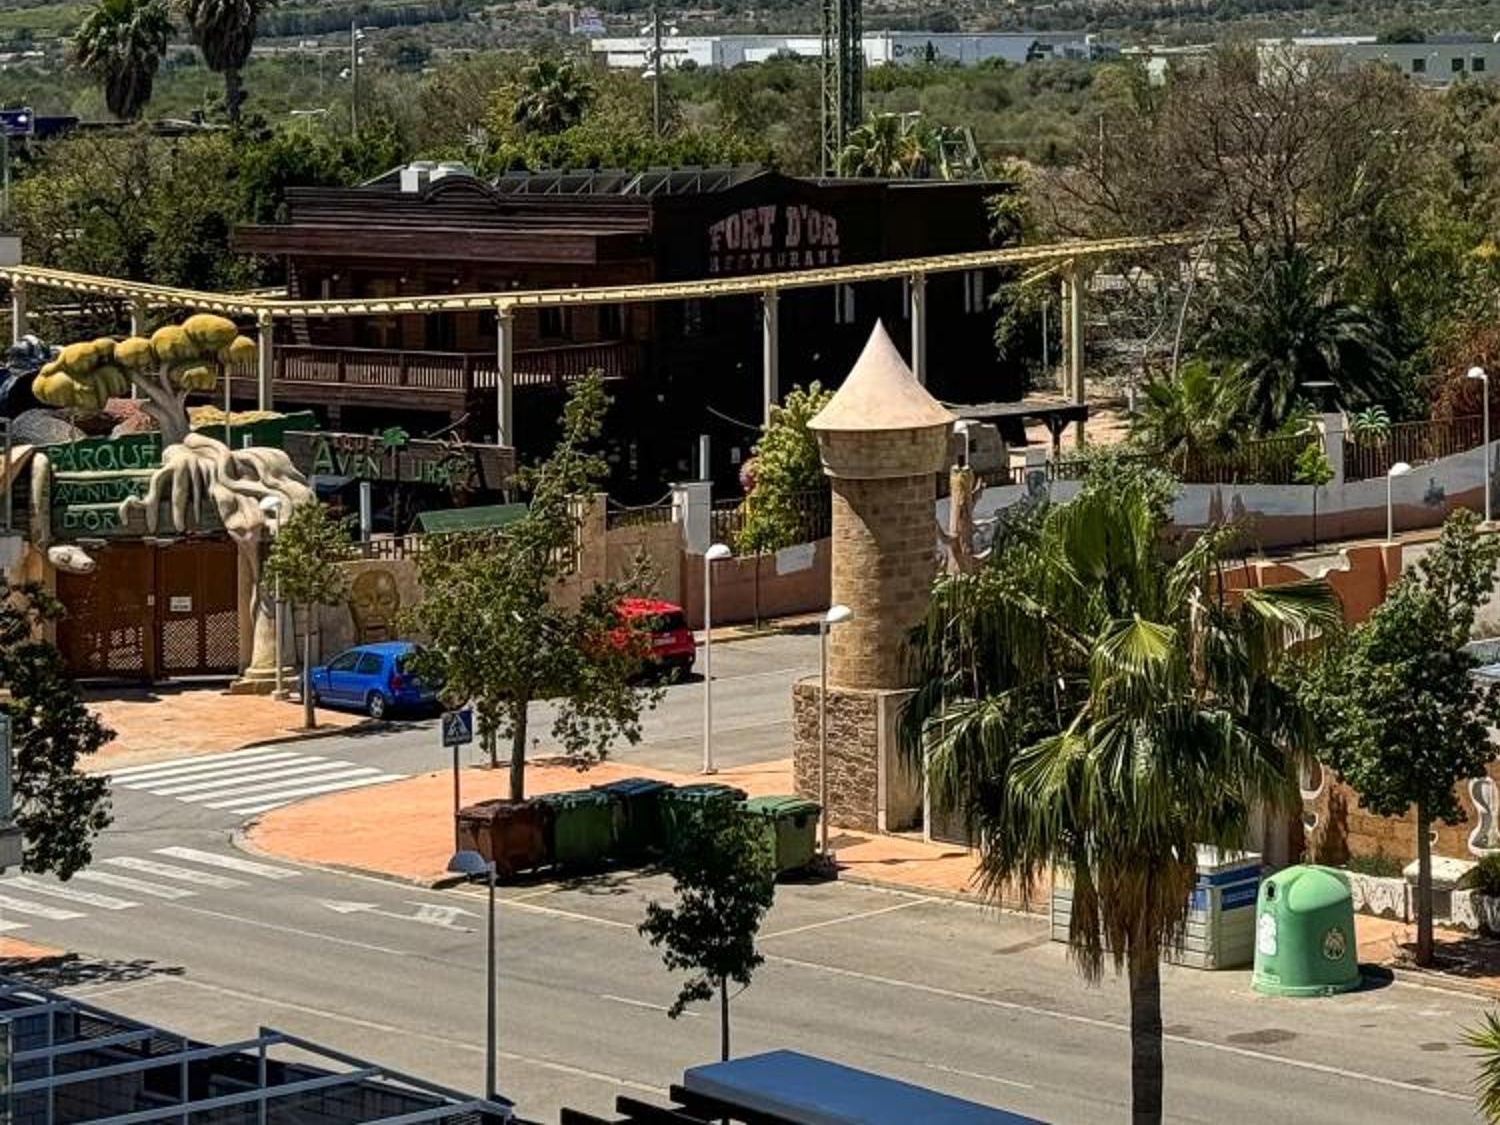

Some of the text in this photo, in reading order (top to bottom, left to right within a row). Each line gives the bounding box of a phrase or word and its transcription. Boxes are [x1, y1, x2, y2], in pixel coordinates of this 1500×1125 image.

[708, 204, 839, 252] FORT D'OR
[47, 442, 159, 471] PARQUE
